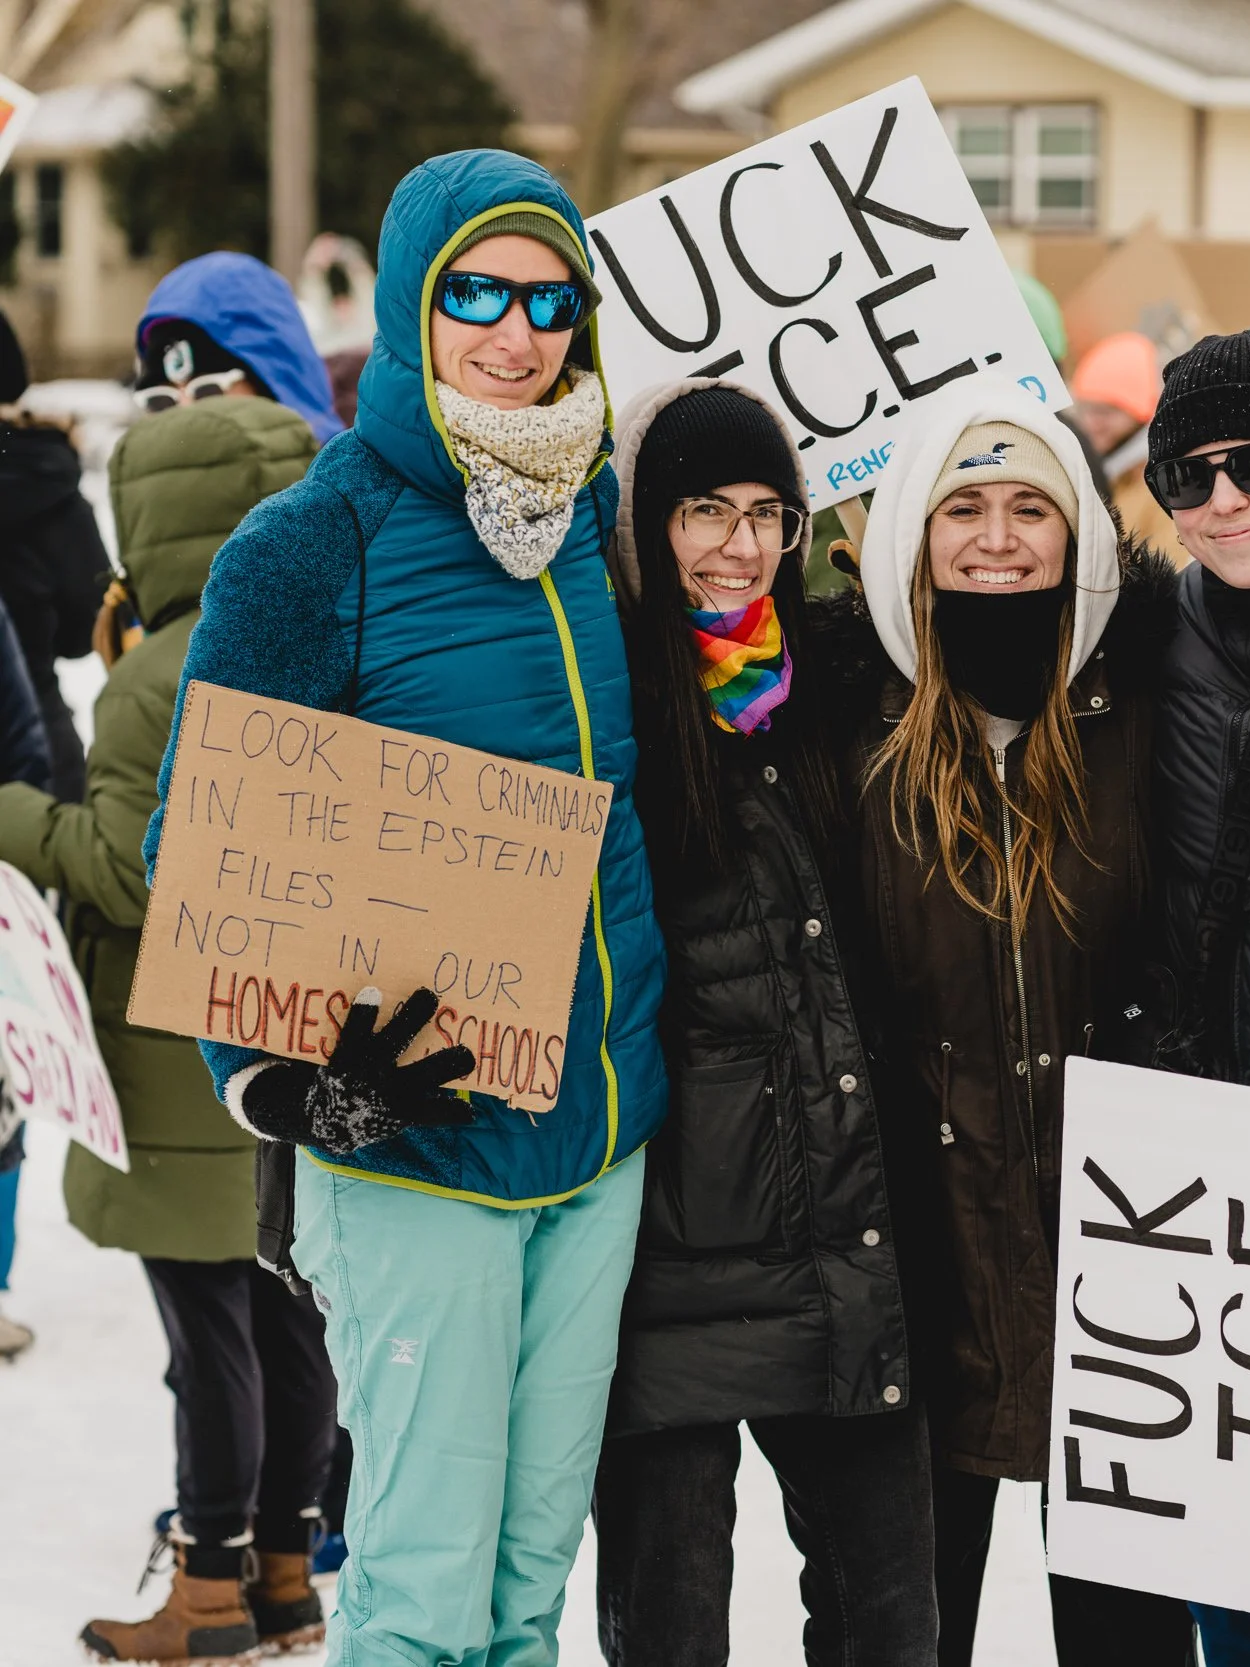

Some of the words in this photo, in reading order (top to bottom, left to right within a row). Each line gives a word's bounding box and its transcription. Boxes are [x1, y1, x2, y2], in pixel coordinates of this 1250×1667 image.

[589, 107, 969, 352] UCK
[200, 699, 342, 782] LOOK
[380, 739, 450, 805] FOR
[478, 763, 607, 836] CRIMINALS
[189, 776, 244, 831] IN
[278, 792, 352, 843] THE
[378, 811, 564, 878] EPSTEIN
[217, 848, 333, 909] FILES
[175, 901, 305, 967] NOT
[339, 934, 380, 976] IN
[434, 952, 522, 1009] OUR
[206, 966, 349, 1060] HOMES
[1063, 1155, 1213, 1520] FUCK
